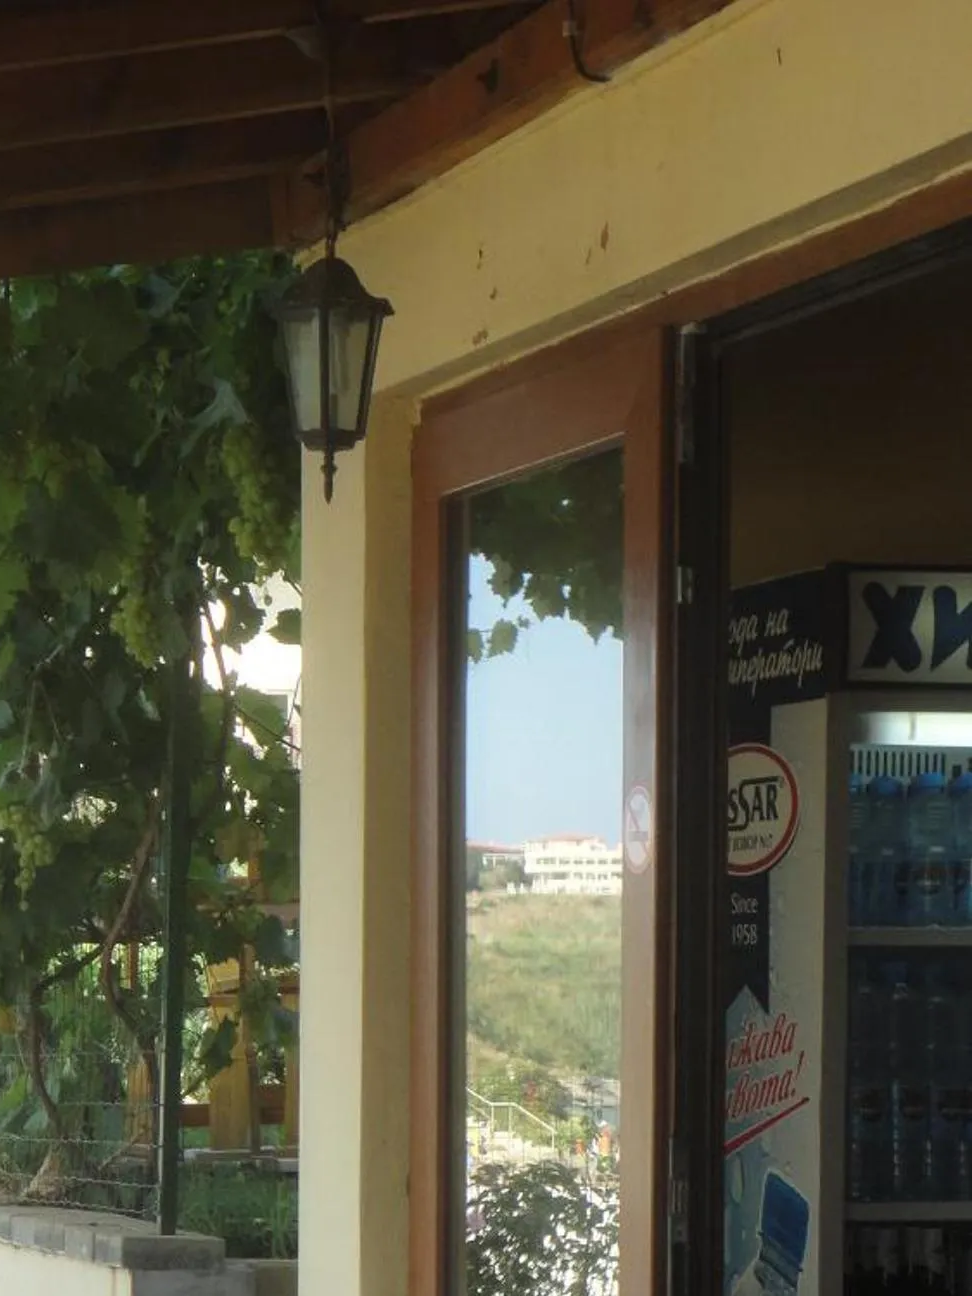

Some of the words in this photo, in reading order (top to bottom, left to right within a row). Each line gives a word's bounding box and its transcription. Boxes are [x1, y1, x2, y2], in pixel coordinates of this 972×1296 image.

[728, 612, 759, 656] ода
[764, 607, 790, 637] на
[728, 776, 780, 831] SSAR
[730, 892, 759, 916] Since
[731, 923, 758, 945] 1958
